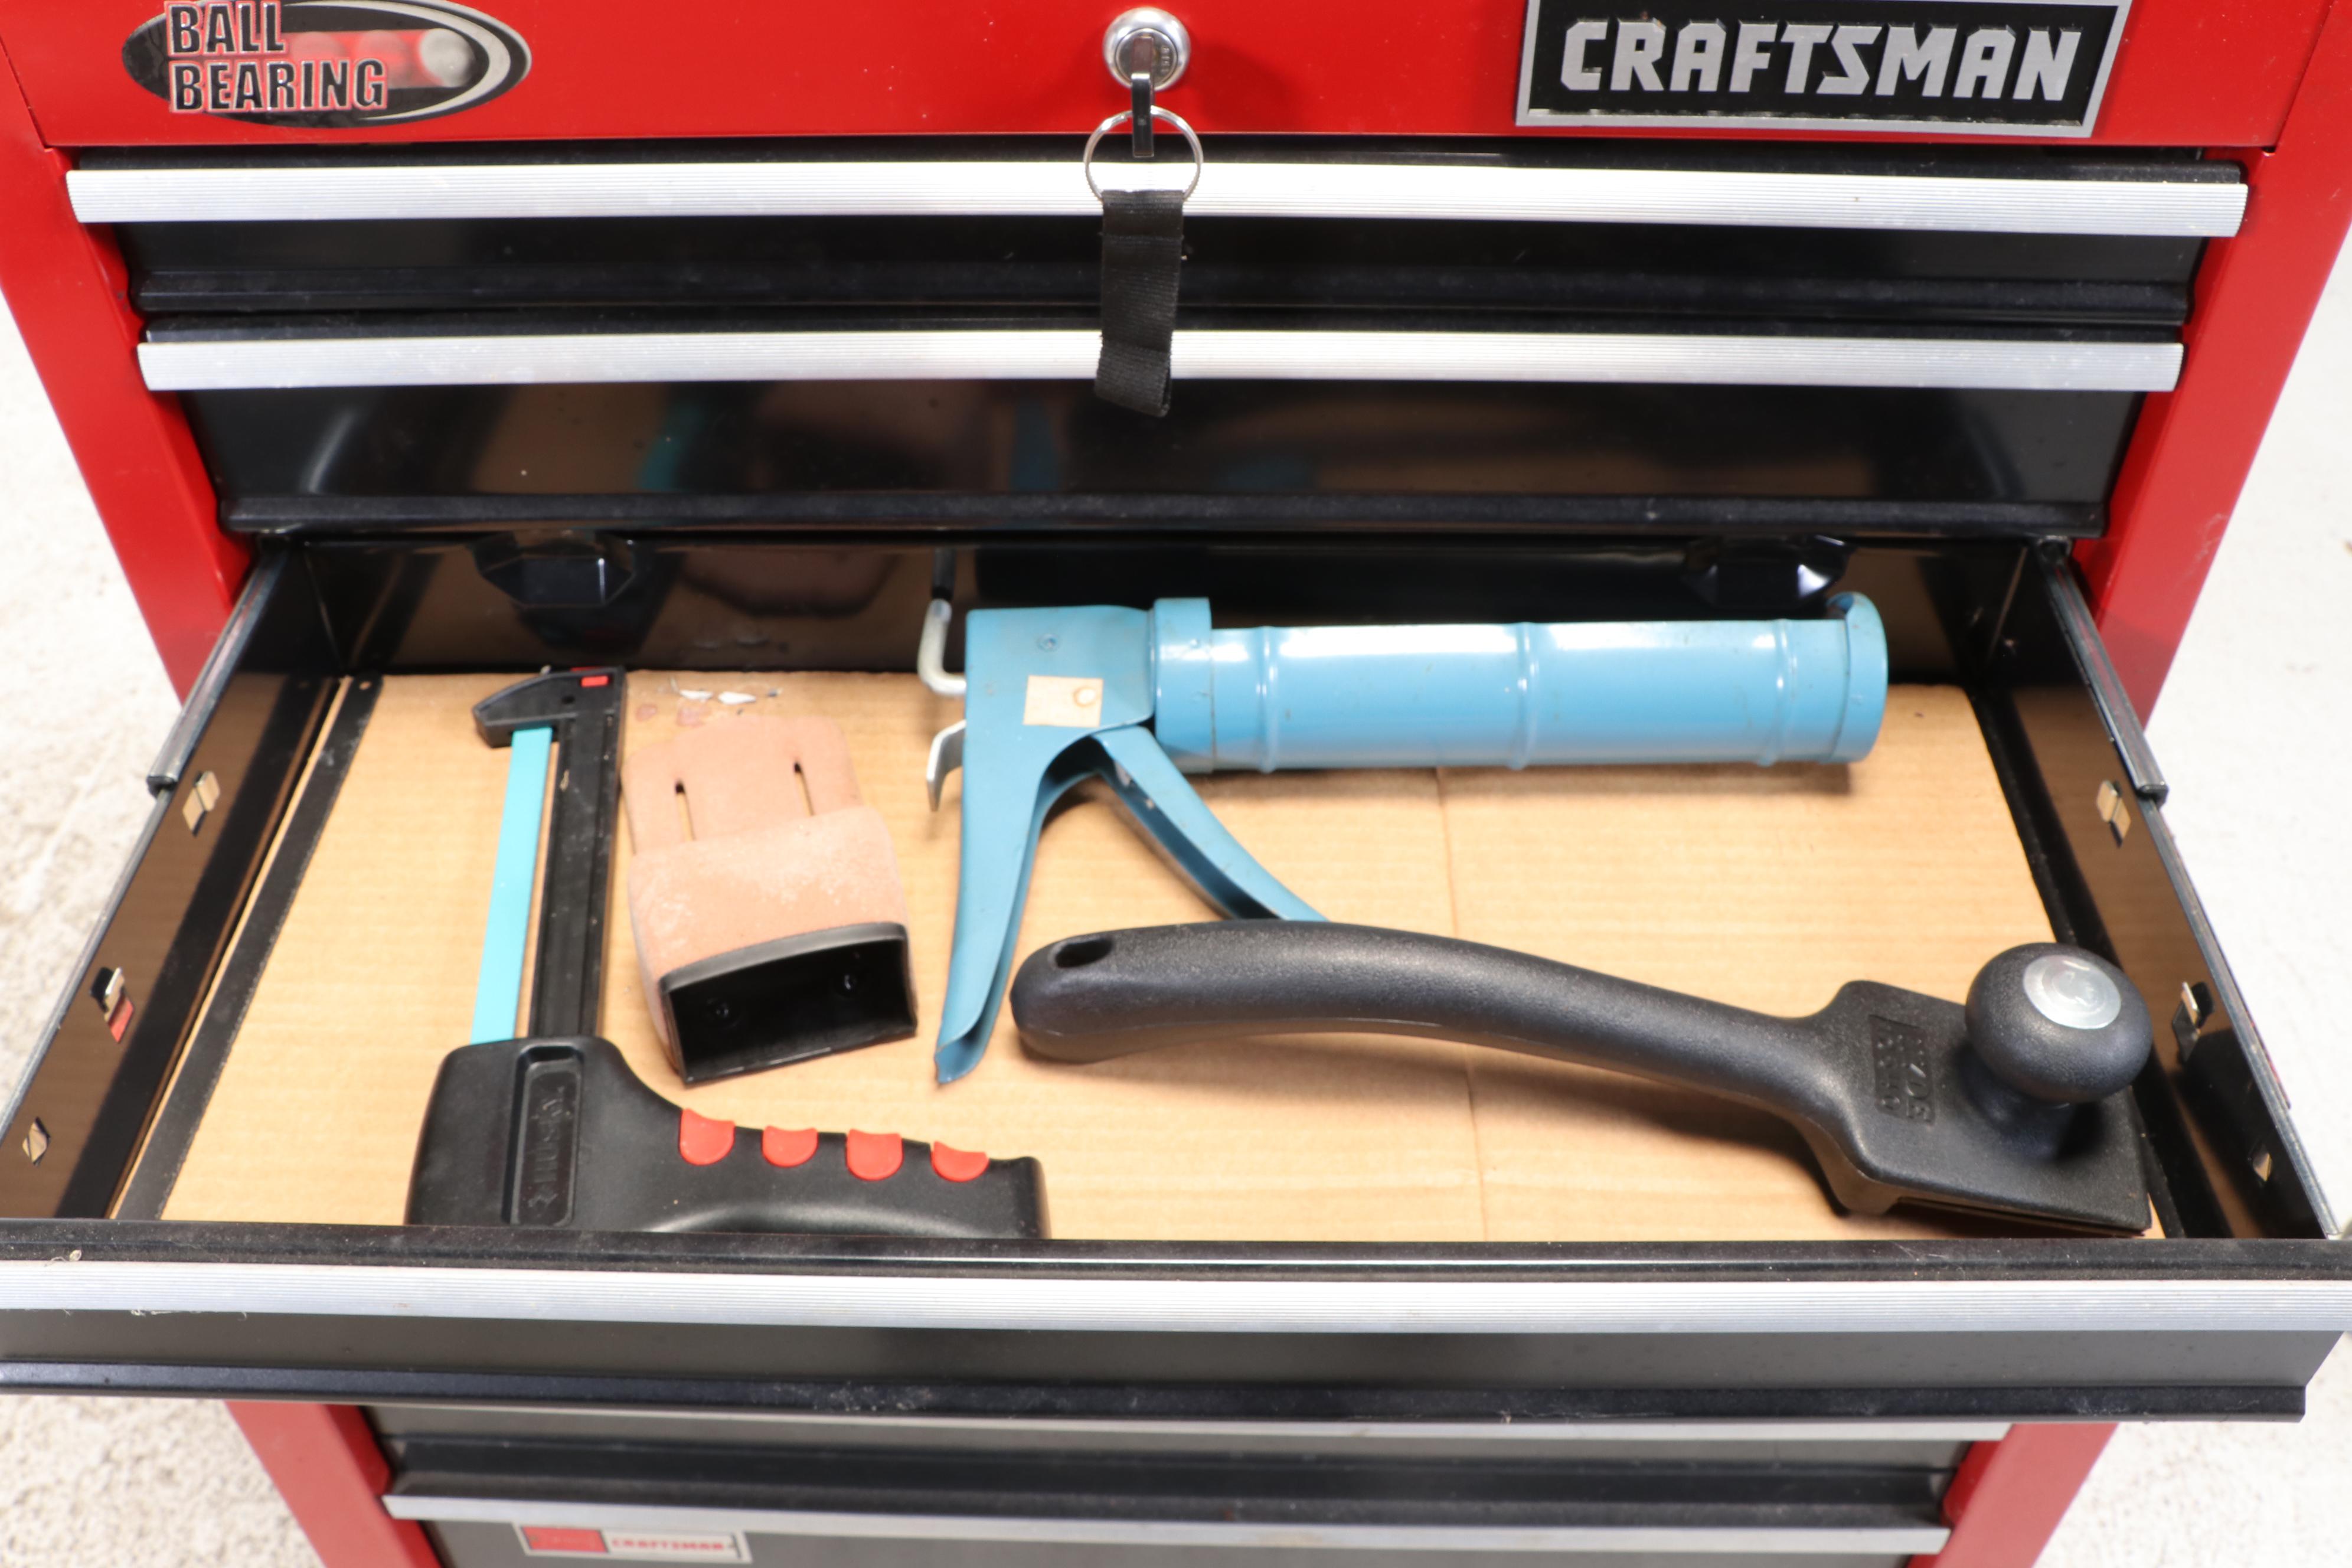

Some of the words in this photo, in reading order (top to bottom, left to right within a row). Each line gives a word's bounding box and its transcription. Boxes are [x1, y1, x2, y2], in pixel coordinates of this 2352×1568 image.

[168, 1, 286, 54] BALL
[171, 60, 387, 111] BEARING
[1560, 18, 2082, 102] CRAFTSMAN
